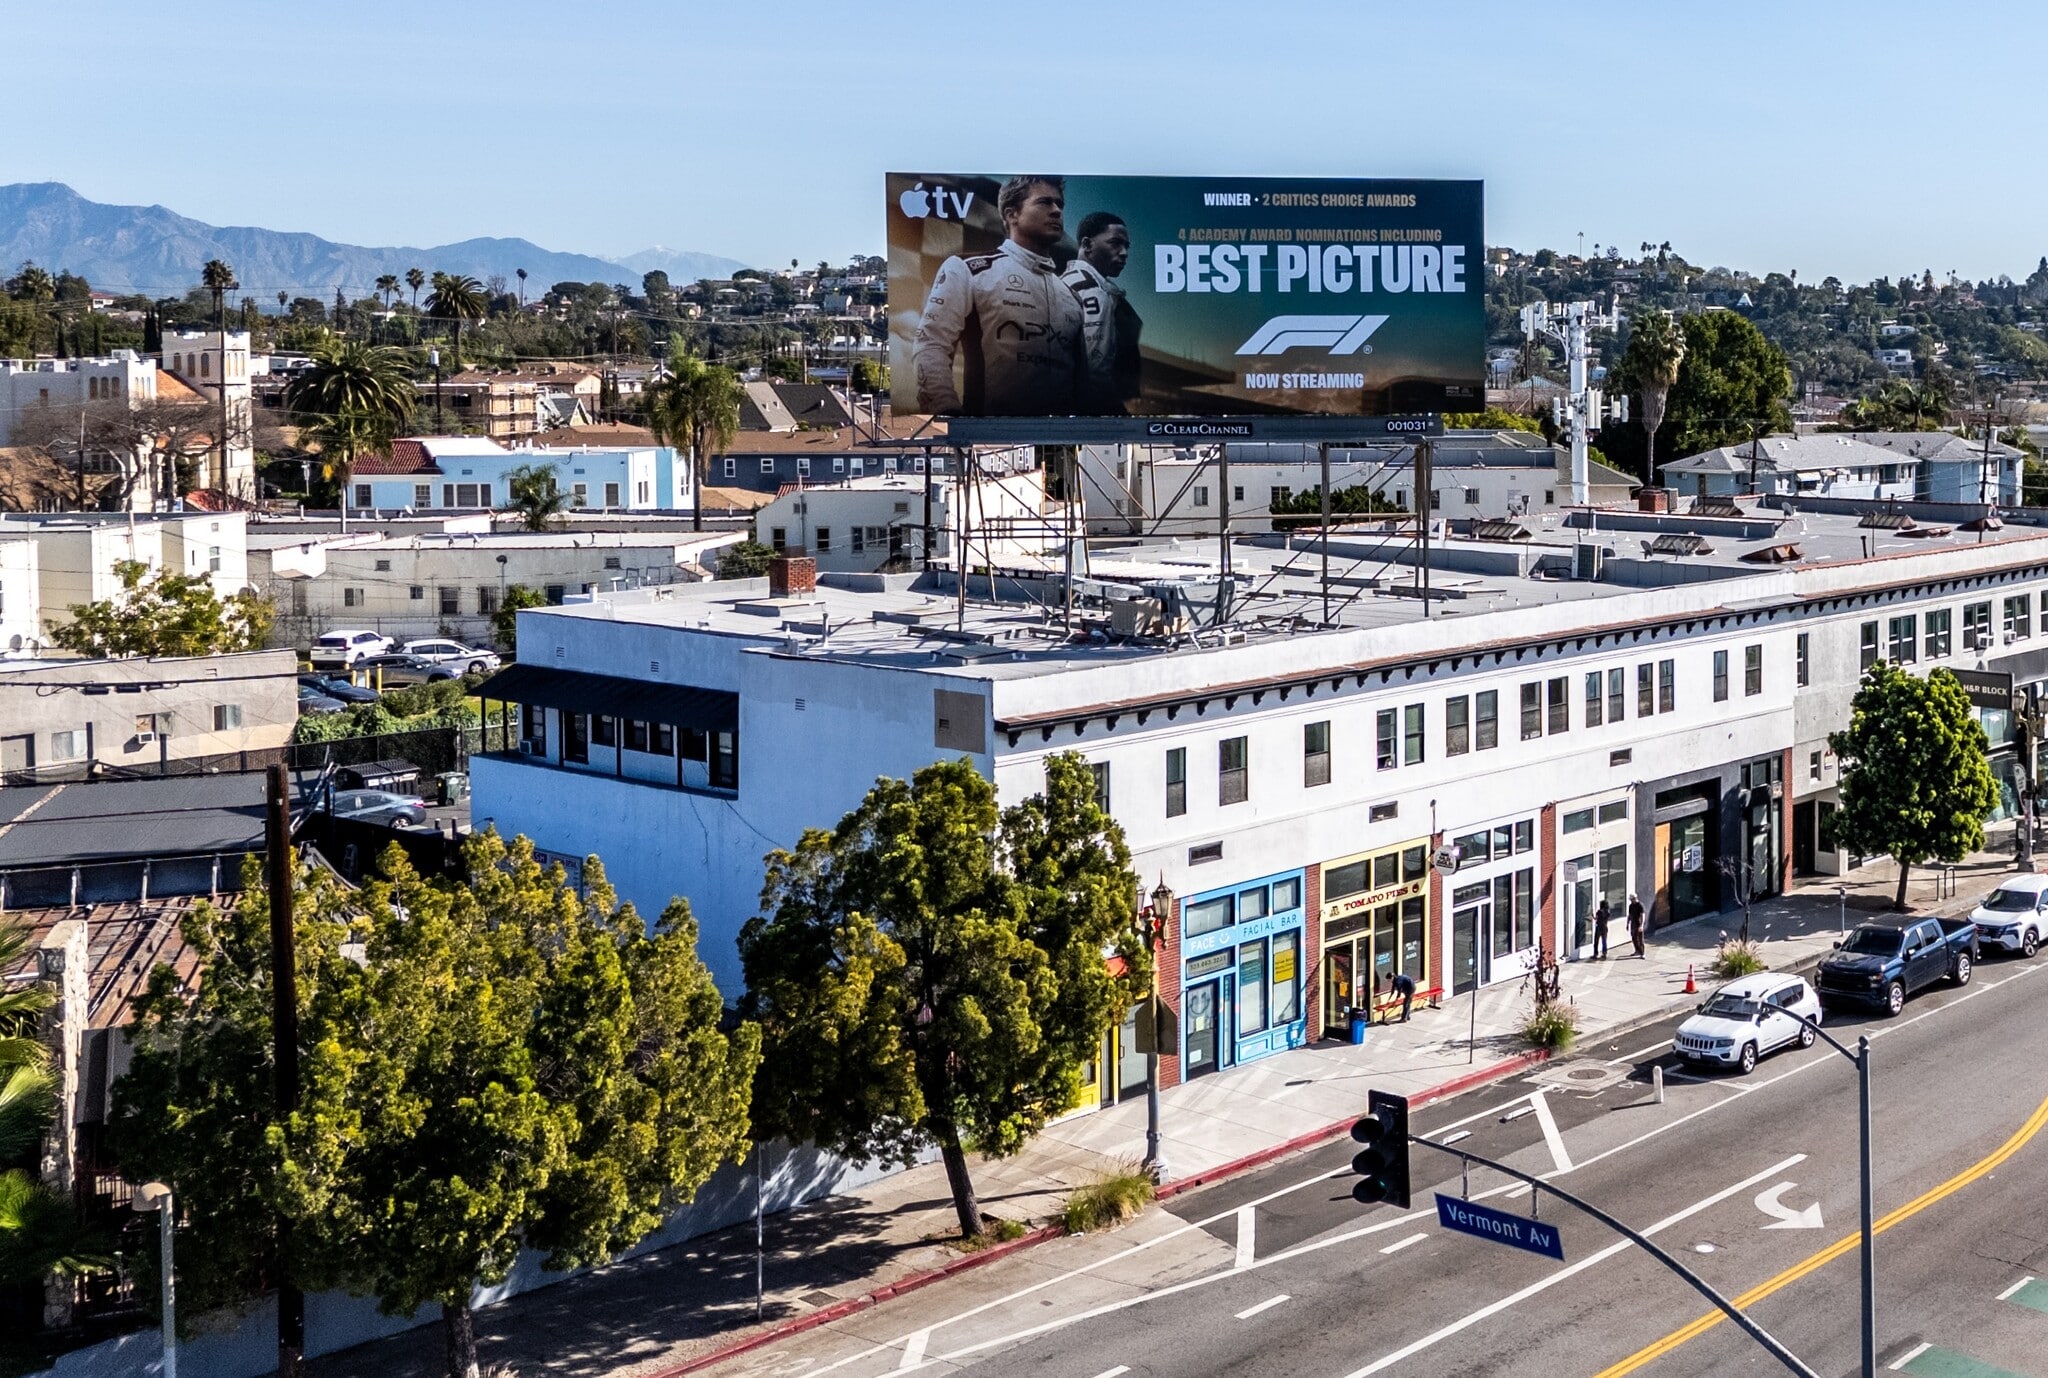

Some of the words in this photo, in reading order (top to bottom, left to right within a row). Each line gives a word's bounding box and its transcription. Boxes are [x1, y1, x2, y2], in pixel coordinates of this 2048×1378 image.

[1203, 193, 1251, 206] WINNER
[1262, 194, 1271, 206] 2
[1272, 194, 1319, 206] CRITICS
[1321, 194, 1364, 207] CHOICE
[1366, 194, 1416, 207] AWARDS
[1178, 228, 1186, 241] 4
[1189, 228, 1247, 241] ACADEMY
[1250, 228, 1292, 241] AWARD
[1296, 229, 1378, 242] NOMINATIONS
[1380, 229, 1442, 242] INCLUDING
[1154, 244, 1268, 293] BEST
[1277, 245, 1466, 293] PICTURE
[1234, 315, 1390, 355] F1
[1245, 373, 1280, 389] NOW
[1282, 373, 1364, 389] STREAMING
[1387, 420, 1426, 431] 001031
[1962, 684, 1980, 694] H&R
[1981, 685, 2008, 696] BLOCK
[1344, 893, 1384, 911] TOMATO
[1386, 887, 1409, 900] PIES
[1190, 936, 1216, 951] FACE
[1243, 921, 1275, 937] FACIAL
[1281, 914, 1298, 927] BAR
[1446, 1203, 1521, 1240] Vermont
[1529, 1227, 1550, 1247] Av
